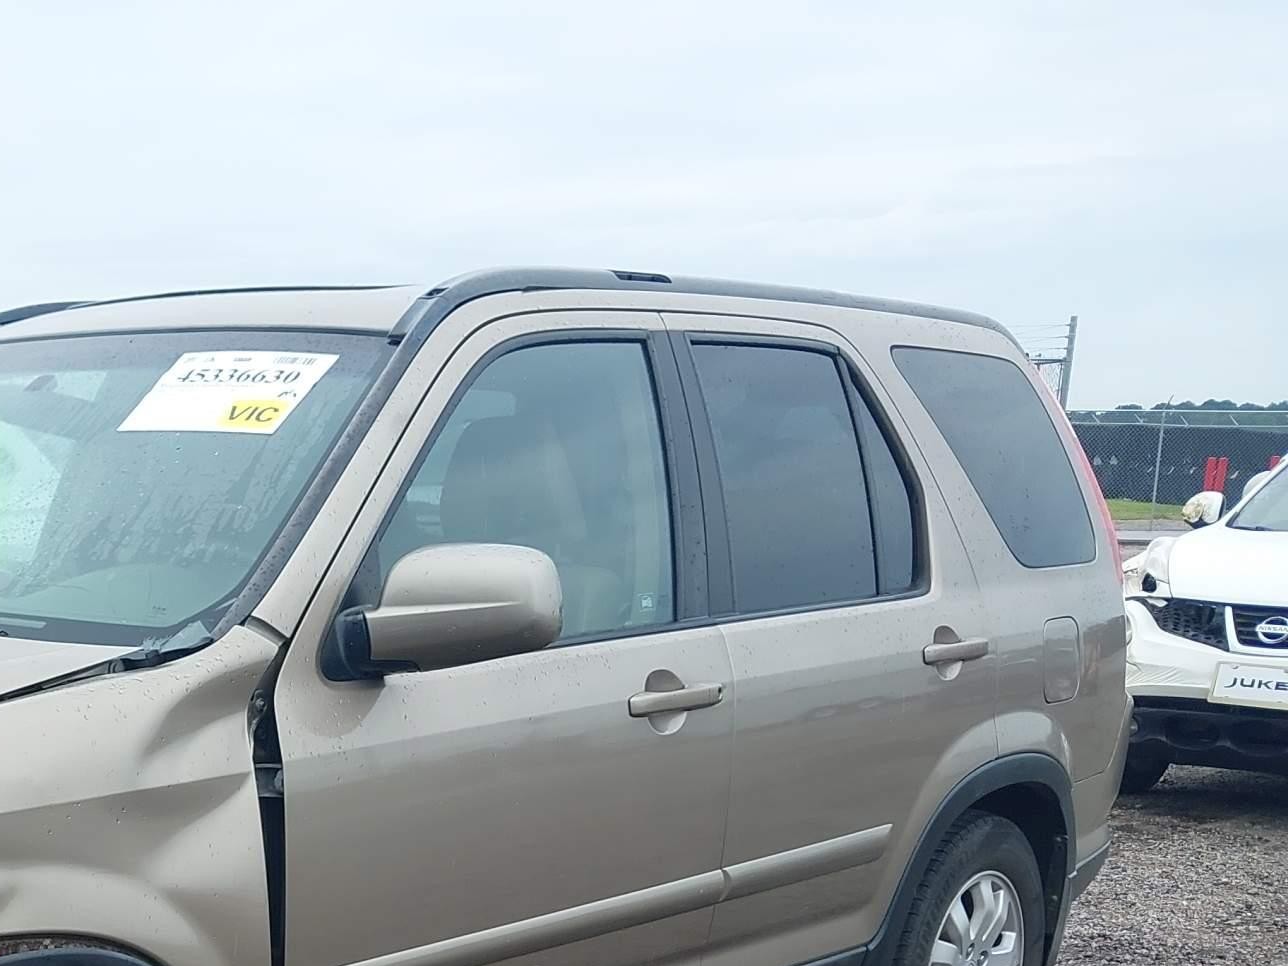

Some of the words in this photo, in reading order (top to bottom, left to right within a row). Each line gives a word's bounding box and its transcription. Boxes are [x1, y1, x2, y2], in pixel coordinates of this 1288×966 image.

[177, 368, 301, 384] 45336630
[228, 405, 279, 422] VIC
[1223, 677, 1288, 691] JUKE
